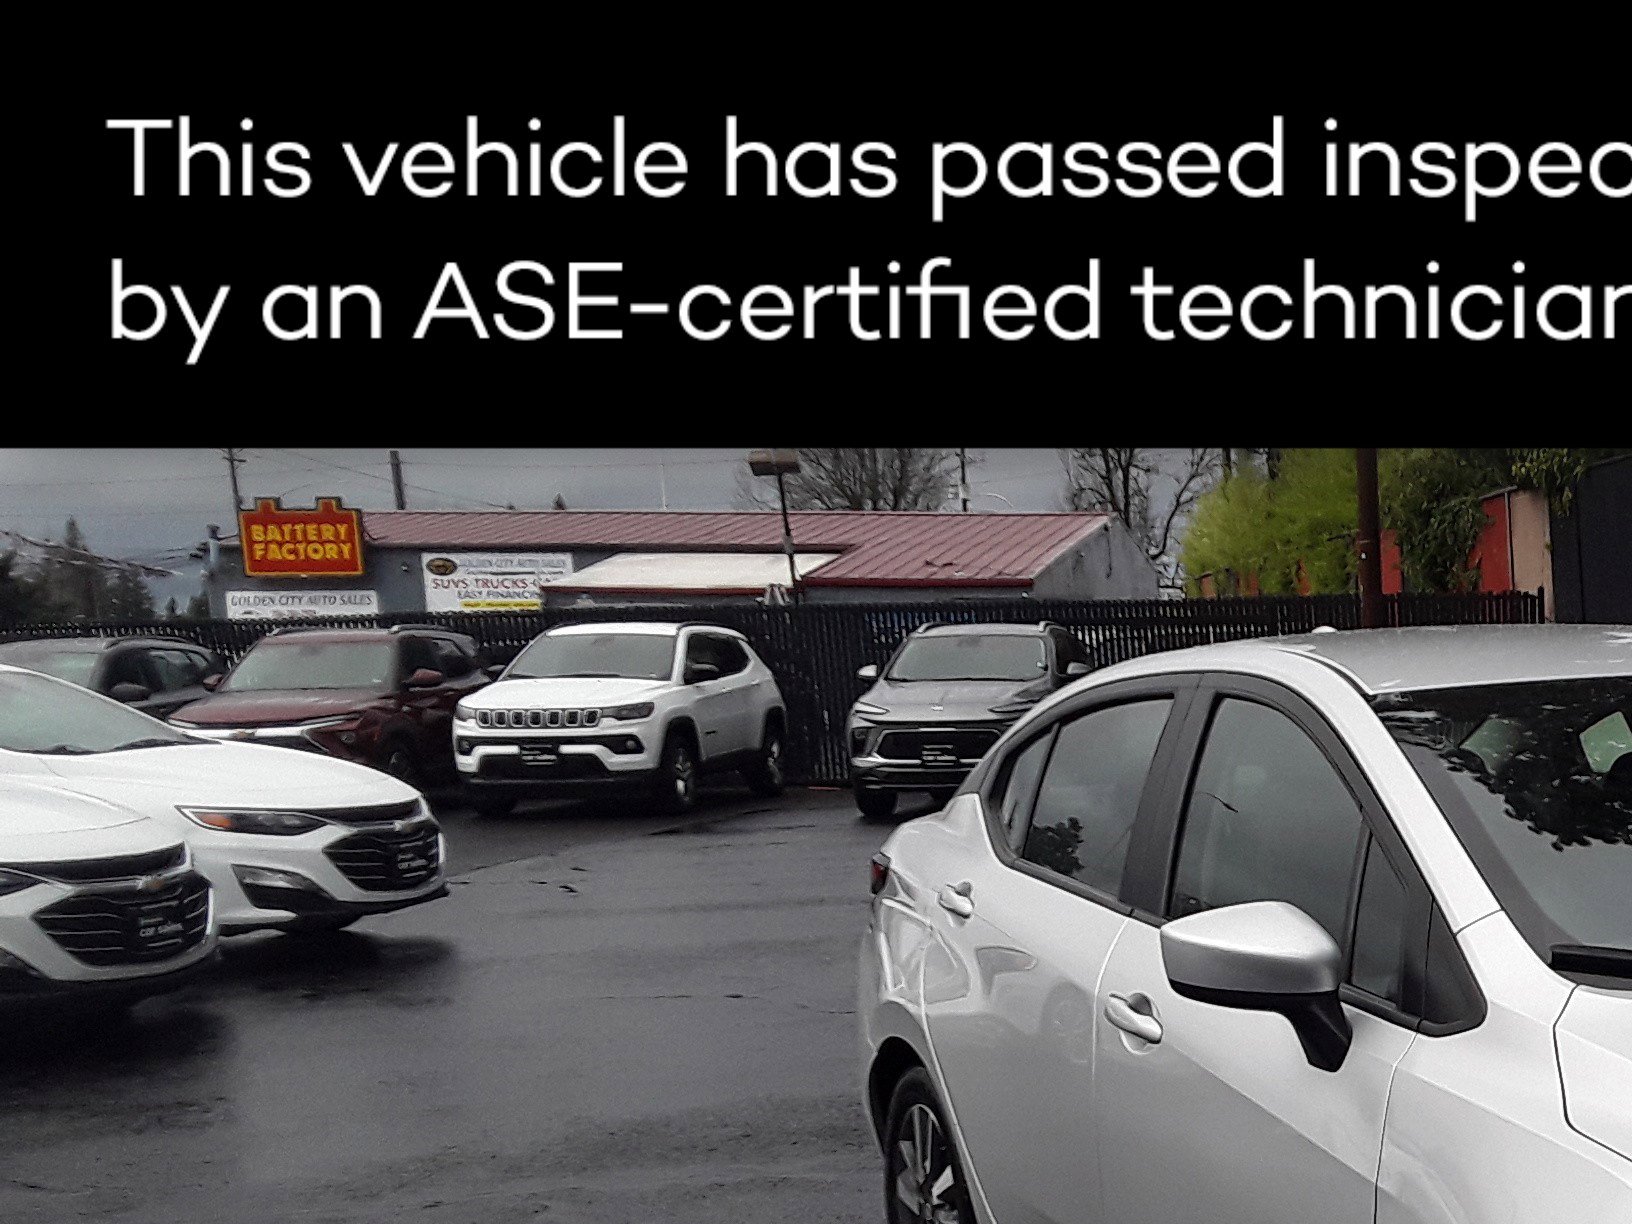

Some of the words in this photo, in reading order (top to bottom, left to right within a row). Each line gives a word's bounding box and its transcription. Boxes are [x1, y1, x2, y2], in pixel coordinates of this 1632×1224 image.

[250, 523, 348, 541] BATTERY
[253, 542, 352, 560] FACTORY
[474, 578, 529, 589] TRUCKS
